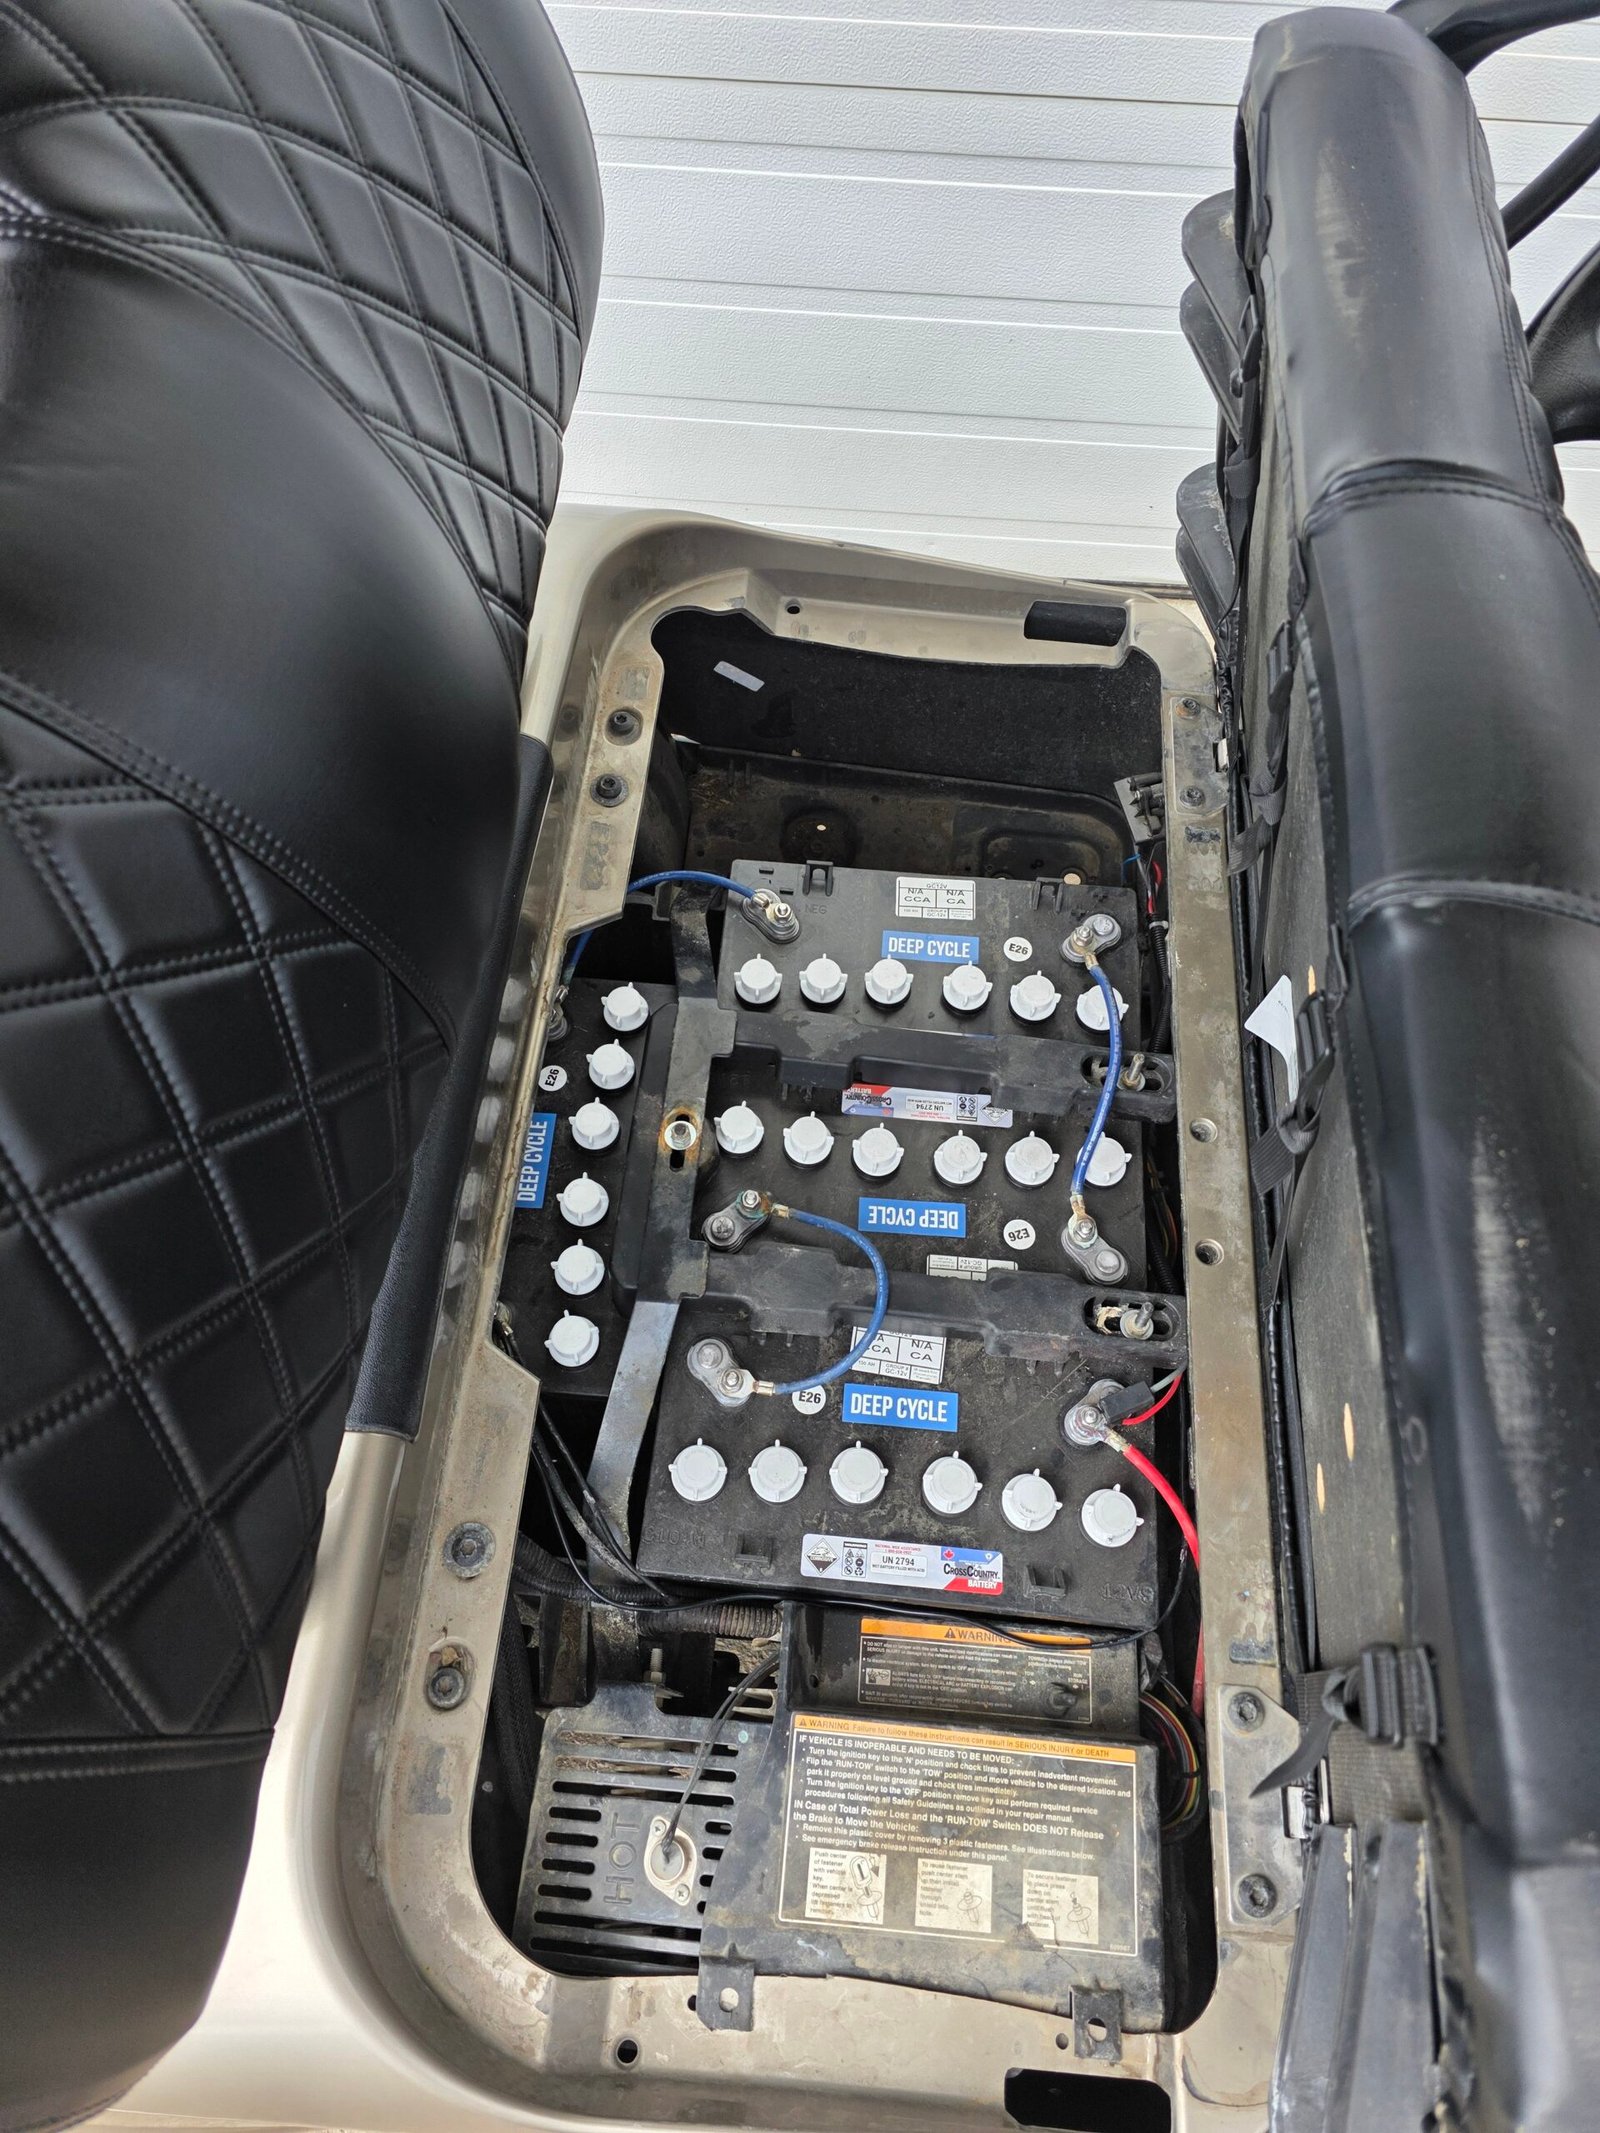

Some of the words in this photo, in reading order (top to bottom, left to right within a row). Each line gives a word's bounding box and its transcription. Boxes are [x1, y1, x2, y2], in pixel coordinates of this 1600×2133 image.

[888, 937, 924, 954] DEEP
[927, 940, 971, 958] CYCLE
[1008, 943, 1029, 955] E26
[544, 1068, 560, 1087] E26
[523, 1120, 548, 1163] CYCLE
[517, 1165, 540, 1202] DEEP
[868, 1205, 915, 1227] CYCLE
[919, 1209, 959, 1230] DEEP
[1008, 1228, 1030, 1242] E26
[910, 1351, 933, 1362] CA
[911, 1340, 933, 1351] N/A
[798, 1391, 821, 1404] E26
[850, 1392, 893, 1417] DEEP
[896, 1399, 948, 1423] CYCLE
[882, 1556, 894, 1564] UN
[895, 1557, 915, 1566] 2794
[967, 1579, 998, 1590] BATTERY
[799, 1734, 807, 1742] IF
[808, 1735, 843, 1746] VEHICLE
[844, 1739, 852, 1747] IS
[854, 1740, 907, 1753] INOPERABLE
[908, 1746, 925, 1755] AND
[927, 1748, 955, 1758] NEEDS
[956, 1751, 967, 1759] TO
[969, 1752, 981, 1760] BE
[982, 1753, 1014, 1764] MOVED:
[809, 1746, 825, 1755] Turn
[826, 1748, 837, 1756] the
[839, 1750, 866, 1760] ignition
[868, 1753, 880, 1762] key
[891, 1755, 902, 1763] the
[914, 1757, 943, 1768] position
[960, 1762, 981, 1771] chock
[983, 1764, 998, 1773] tires
[1000, 1766, 1007, 1774] to
[1009, 1767, 1036, 1778] prevent
[1037, 1770, 1077, 1781] inadvertent
[1079, 1774, 1118, 1785] movement.
[806, 1757, 819, 1766] Flip
[821, 1758, 832, 1766] the
[875, 1764, 898, 1773] switch
[900, 1766, 907, 1774] to
[908, 1767, 920, 1775] the
[974, 1774, 987, 1782] and
[1010, 1778, 1036, 1787] vehicle
[1046, 1781, 1057, 1789] the
[1117, 1789, 1131, 1797] and
[806, 1767, 823, 1777] park
[830, 1770, 860, 1781] properly
[873, 1774, 890, 1782] level
[891, 1776, 917, 1786] ground
[919, 1779, 932, 1787] and
[934, 1781, 955, 1789] chock
[804, 1788, 845, 1800] procedures
[847, 1793, 880, 1804] following
[892, 1797, 914, 1807] Safety
[916, 1800, 954, 1810] Guidelines
[1005, 1810, 1021, 1818] your
[1046, 1813, 1074, 1822] manual.
[806, 1778, 822, 1786] Turn
[837, 1781, 864, 1791] ignition
[866, 1784, 878, 1793] key
[880, 1785, 888, 1793] to
[889, 1786, 901, 1794] the
[923, 1790, 951, 1800] position
[953, 1794, 979, 1802] remove
[995, 1797, 1008, 1805] and
[1072, 1805, 1098, 1814] service
[793, 1811, 806, 1821] the
[808, 1813, 833, 1824] Brake
[835, 1816, 844, 1825] to
[845, 1817, 868, 1827] Move
[870, 1819, 883, 1829] the
[885, 1821, 919, 1832] Vehicle:
[794, 1800, 803, 1808] IN
[804, 1801, 826, 1811] Case
[828, 1803, 837, 1812] of
[838, 1804, 859, 1814] Total
[861, 1806, 887, 1817] Power
[889, 1809, 909, 1819] Loss
[912, 1812, 927, 1821] and
[929, 1813, 943, 1823] the
[992, 1820, 1020, 1831] Switch
[1023, 1823, 1048, 1834] DOES
[1050, 1826, 1069, 1836] NOT
[1071, 1828, 1104, 1839] Release
[802, 1834, 816, 1842] See
[817, 1837, 857, 1847] emergency
[909, 1845, 947, 1855] instruction
[949, 1849, 970, 1858] under
[987, 1853, 1008, 1863] panel.
[803, 1823, 832, 1833] Remove
[849, 1828, 873, 1838] plastic
[896, 1833, 905, 1842] by
[907, 1834, 941, 1845] removing
[974, 1841, 1009, 1851] fasteners.
[1011, 1845, 1026, 1853] See
[602, 1811, 640, 1905] HOT
